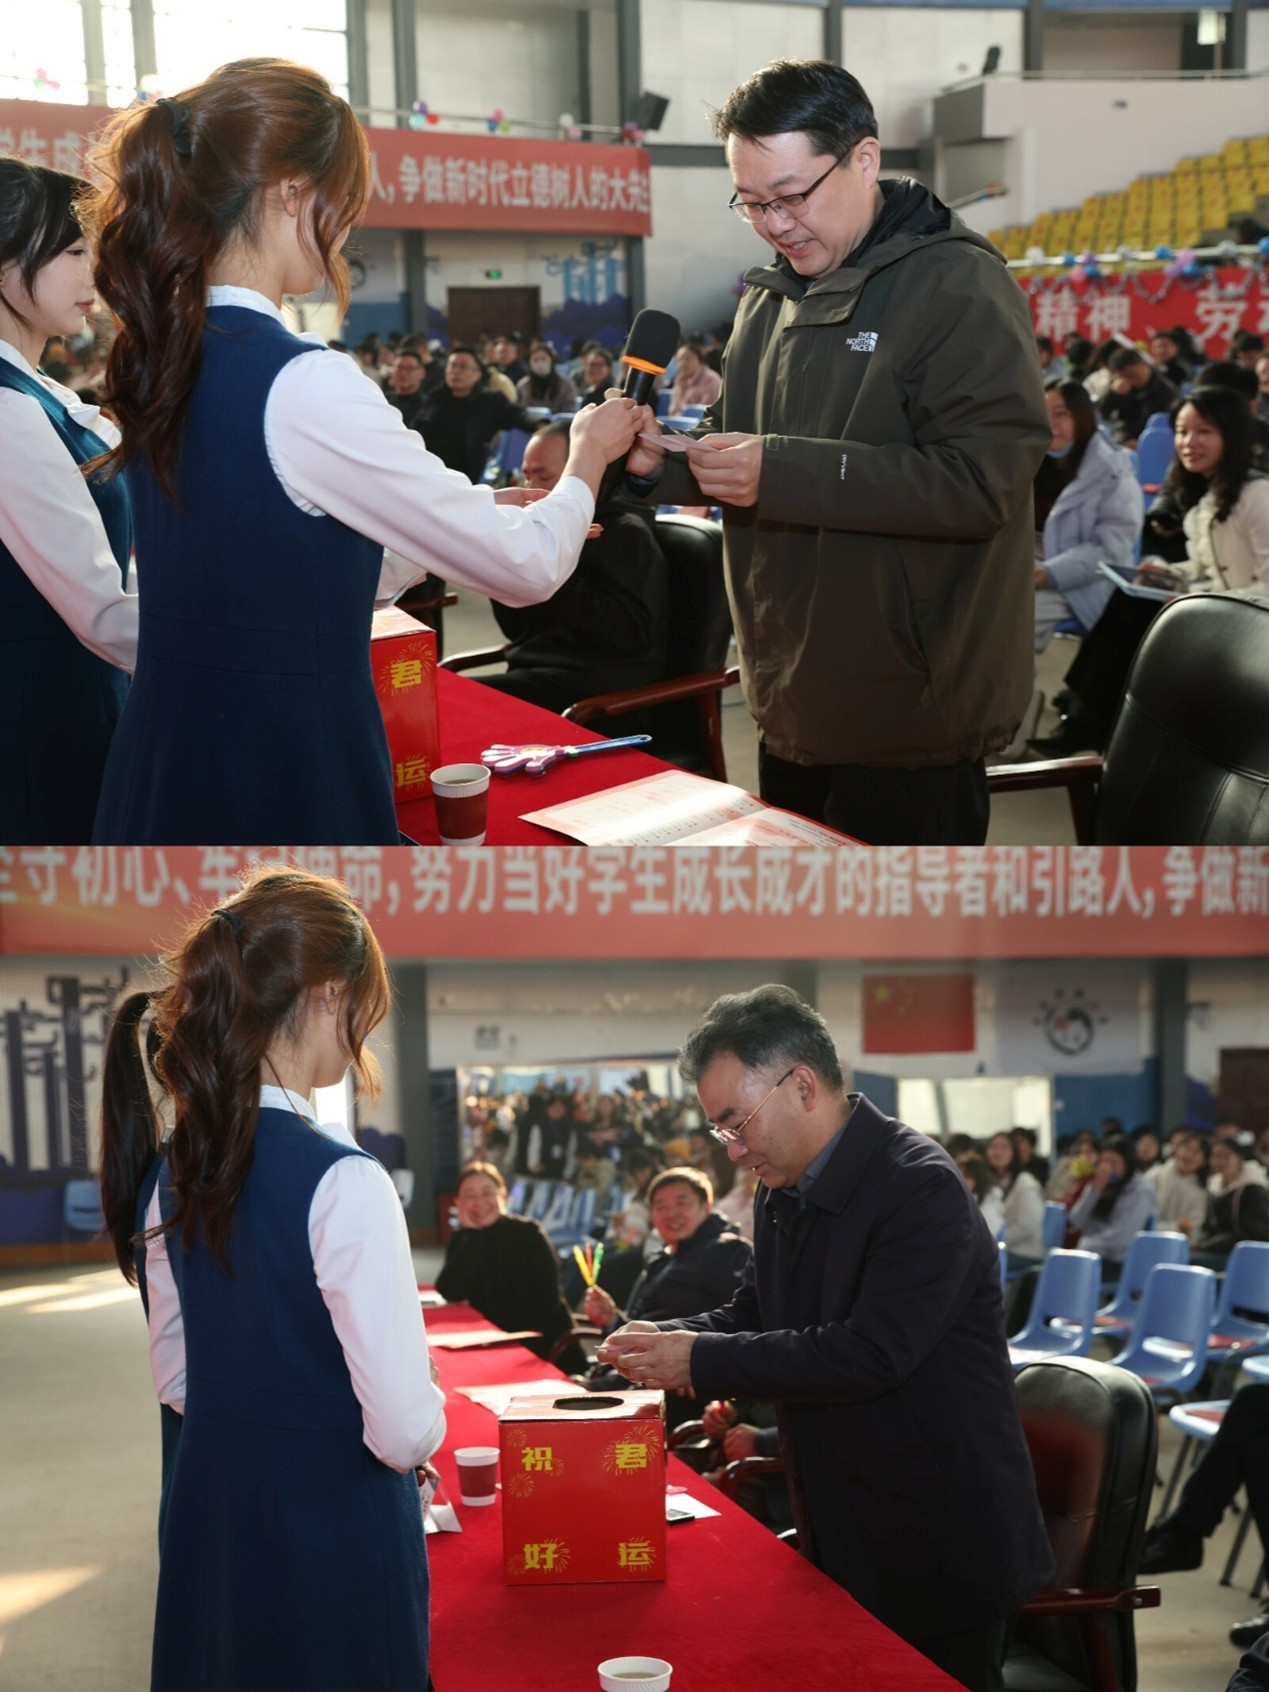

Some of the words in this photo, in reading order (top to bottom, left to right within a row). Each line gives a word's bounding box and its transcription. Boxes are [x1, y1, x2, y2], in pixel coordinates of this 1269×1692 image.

[1034, 287, 1131, 341] 精神
[1195, 283, 1269, 341] 劳
[845, 337, 870, 347] NORTH
[850, 344, 870, 352] FACE
[858, 331, 871, 340] THE
[390, 660, 422, 688] 君
[395, 758, 428, 786] 运
[521, 1446, 553, 1471] 祝
[615, 1443, 648, 1468] 君
[524, 1543, 558, 1569] 好
[619, 1542, 650, 1566] 运
